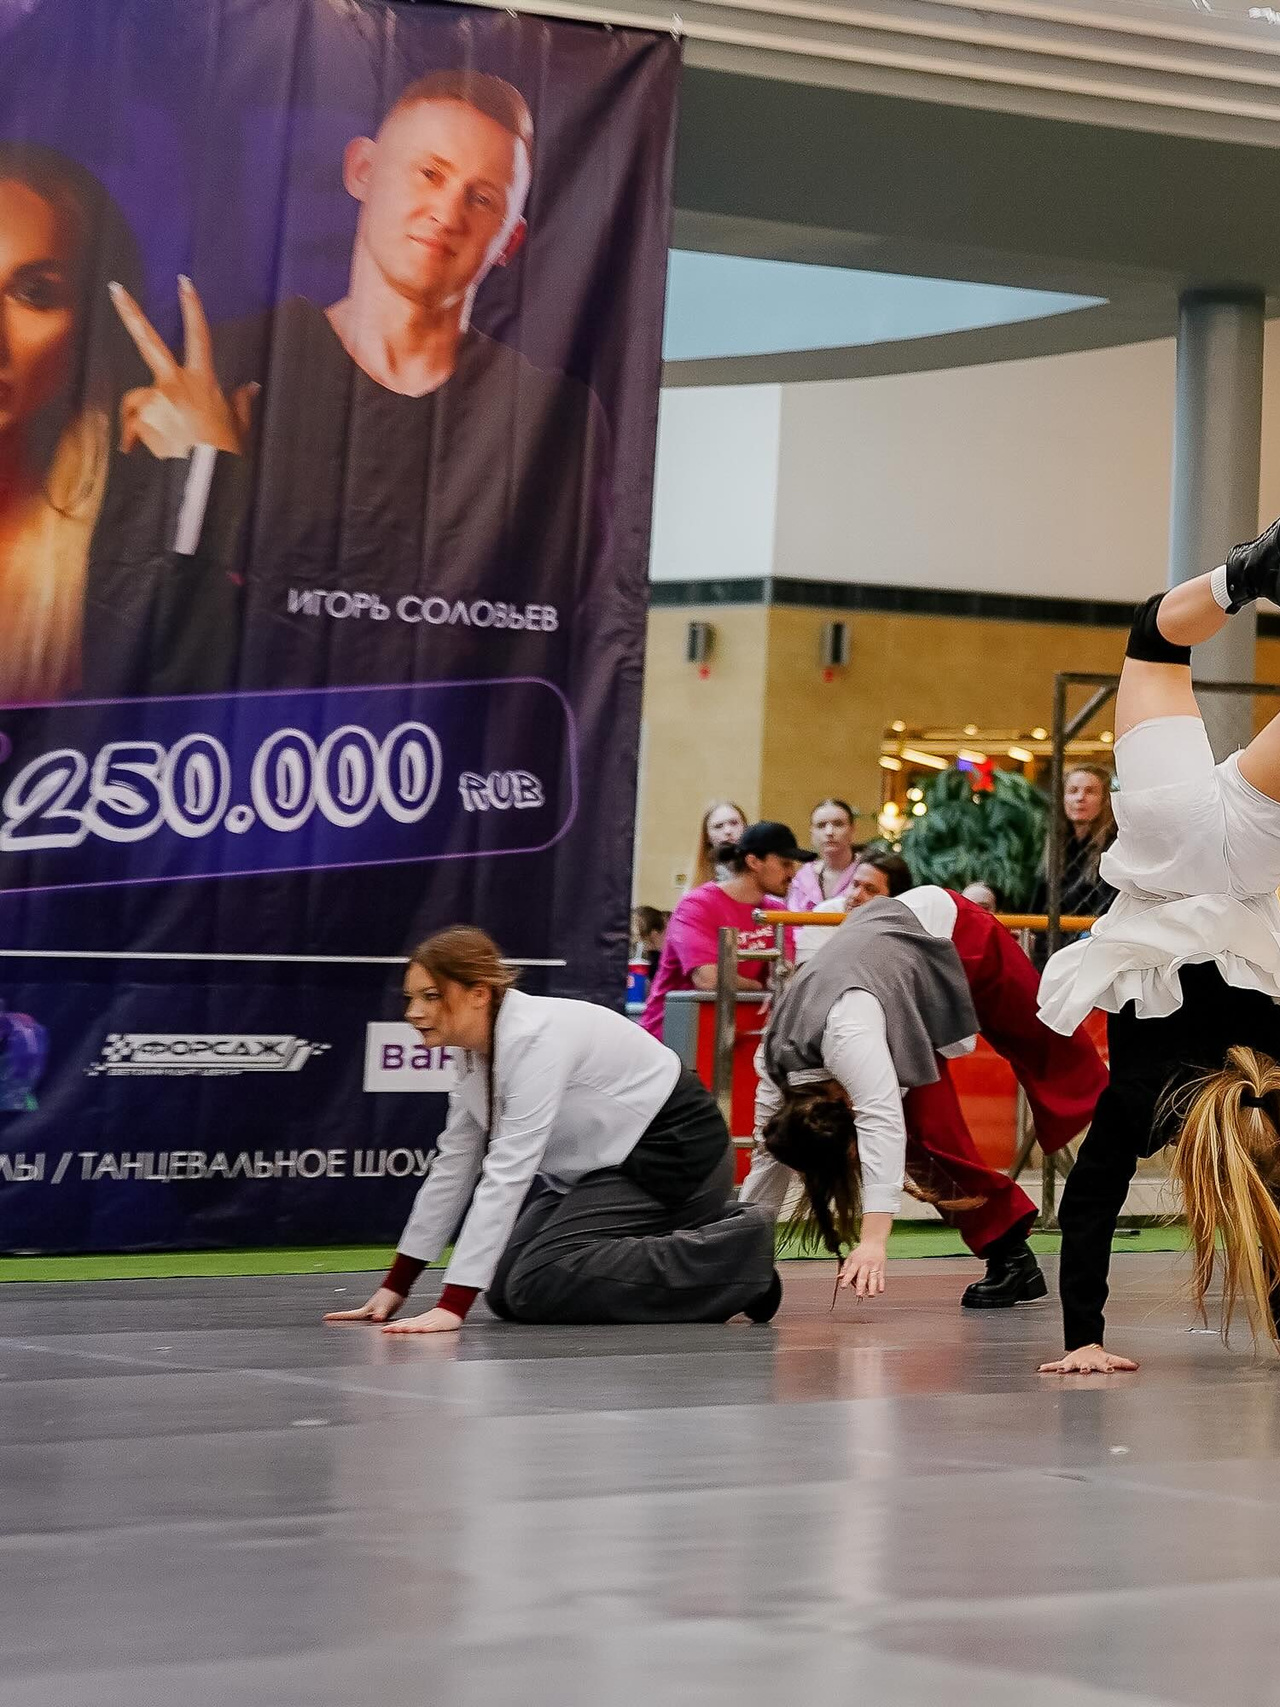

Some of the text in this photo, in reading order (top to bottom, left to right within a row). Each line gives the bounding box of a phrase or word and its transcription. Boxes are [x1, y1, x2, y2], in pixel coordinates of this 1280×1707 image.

[287, 588, 559, 632] ИГОРЬ СОЛОВЬЕВ
[0, 721, 546, 852] 250.000 RUB
[77, 1149, 347, 1183] ТАНЦЕВАЛЬНОЕ
[353, 1148, 438, 1177] ШОУ
